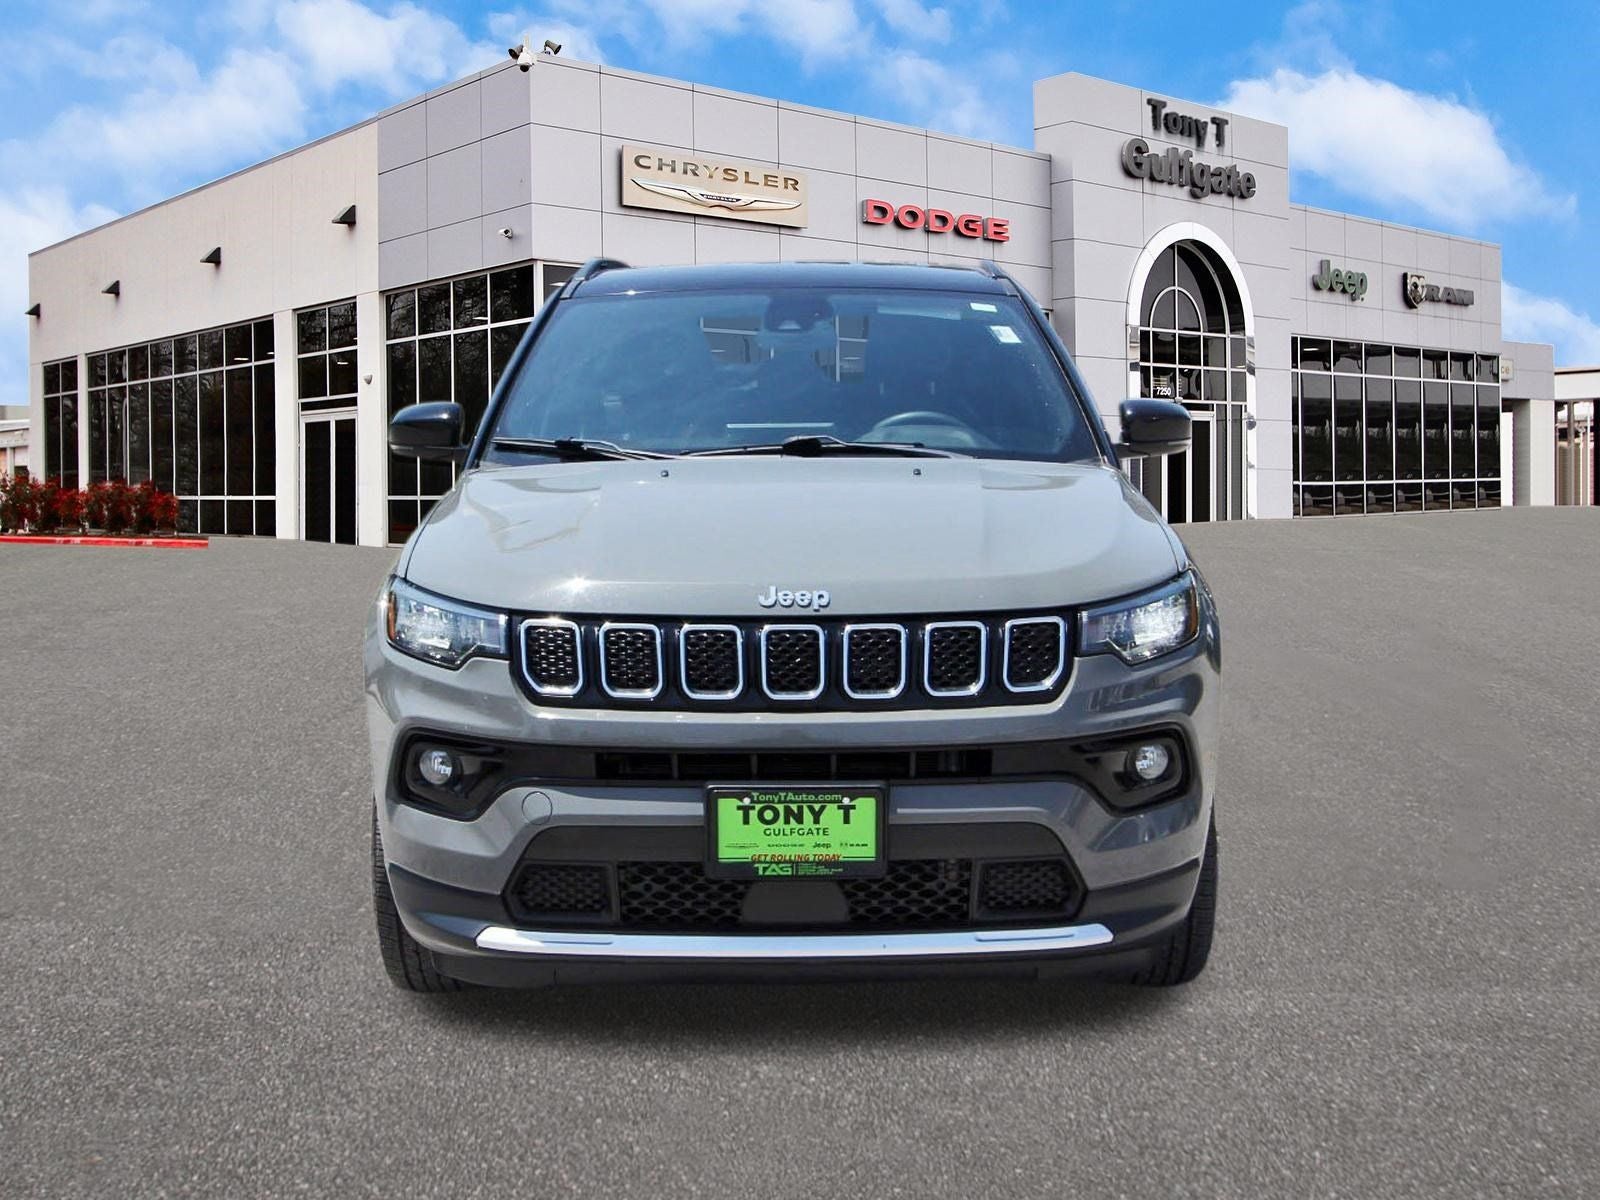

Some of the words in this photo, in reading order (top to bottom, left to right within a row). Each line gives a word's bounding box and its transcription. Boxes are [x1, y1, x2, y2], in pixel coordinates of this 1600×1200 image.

[1146, 98, 1208, 147] Tony
[1210, 116, 1229, 147] T
[633, 154, 800, 192] CHRYSLER
[1121, 137, 1257, 199] Gulfgate
[862, 198, 1010, 242] DODGE
[1312, 259, 1368, 302] Jeep
[1424, 284, 1474, 306] RAM
[1156, 386, 1172, 396] 7250
[758, 585, 831, 612] Jeep
[751, 792, 842, 802] TonyTAuto.com
[736, 804, 827, 826] TONY
[837, 804, 856, 825] T
[763, 827, 830, 837] GULFGATE
[751, 854, 769, 862] GET
[770, 854, 810, 862] ROLLING
[812, 854, 842, 862] TODAY
[753, 863, 792, 875] TAG
